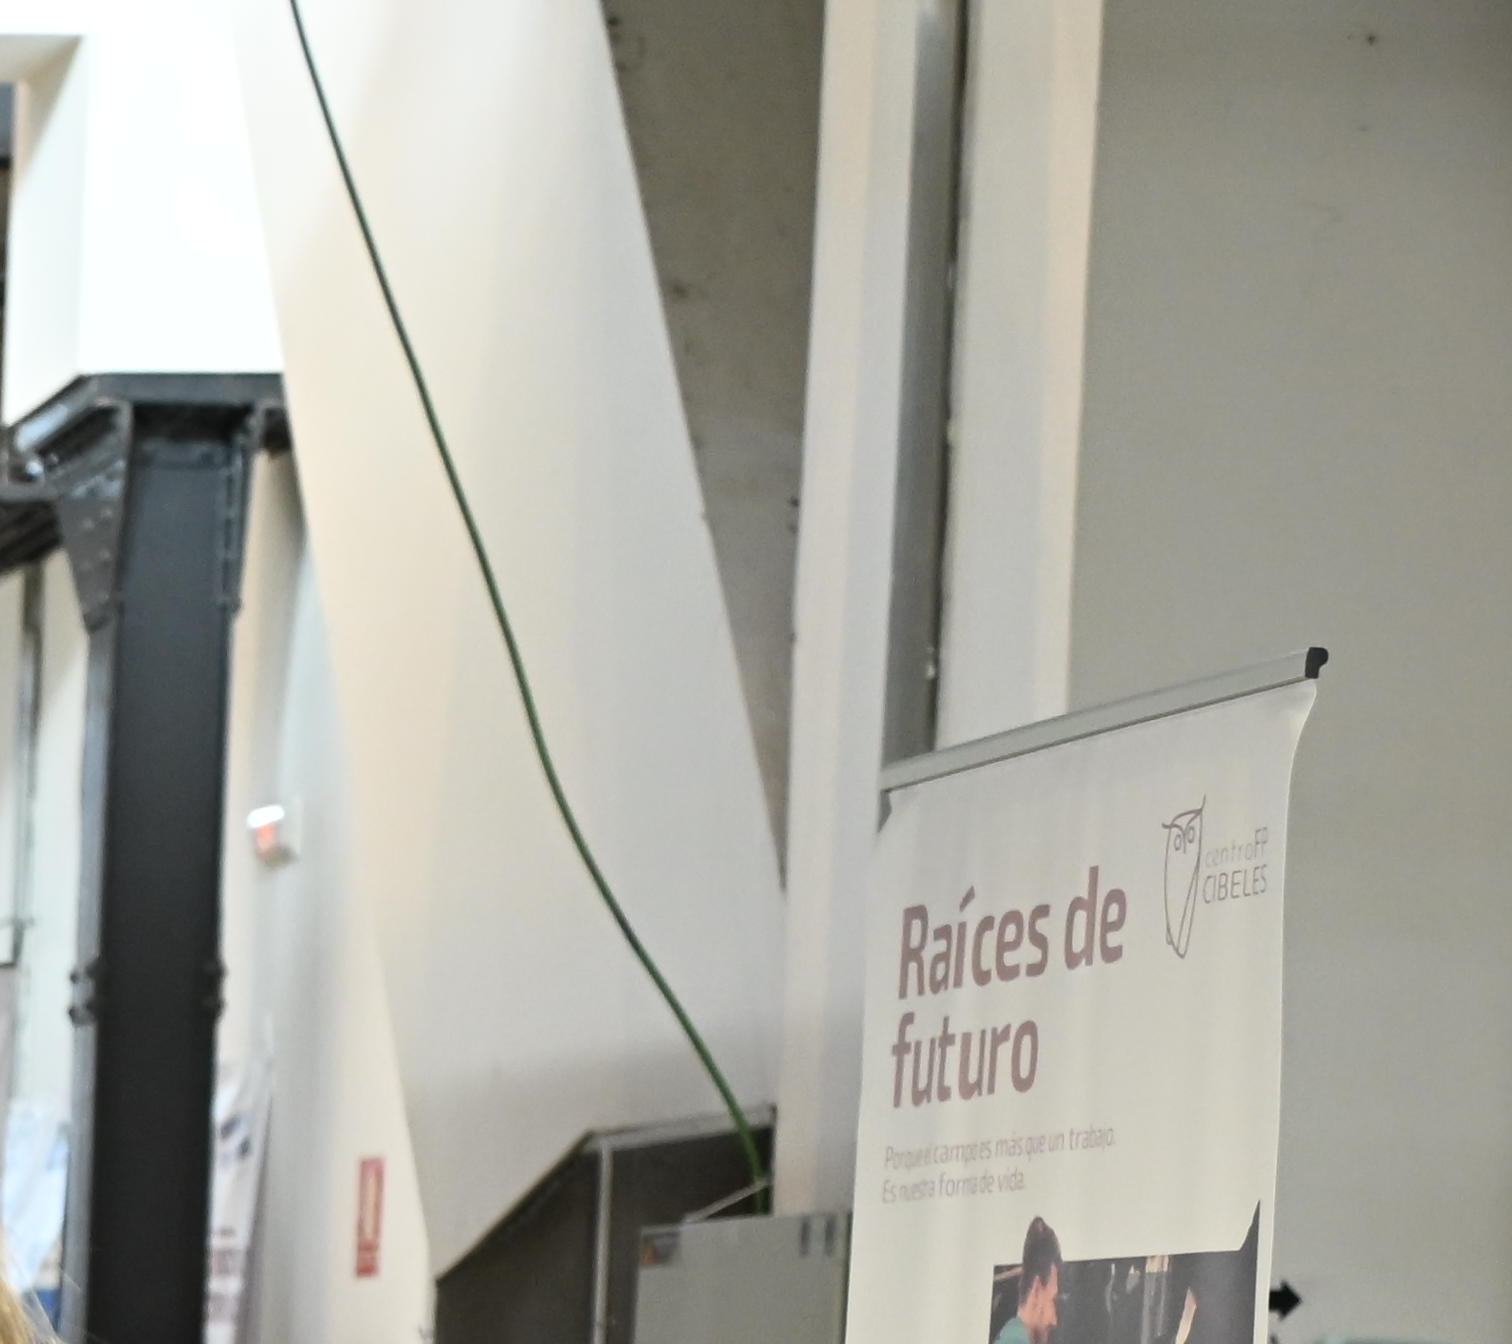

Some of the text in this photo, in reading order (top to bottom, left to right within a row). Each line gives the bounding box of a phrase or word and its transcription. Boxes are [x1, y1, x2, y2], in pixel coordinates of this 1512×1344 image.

[1203, 863, 1268, 904] CIBELES
[898, 865, 1128, 999] Raíces de
[891, 1012, 1040, 1108] futuro
[995, 1131, 1023, 1158] más
[1025, 1134, 1046, 1161] que
[1048, 1131, 1066, 1152] un
